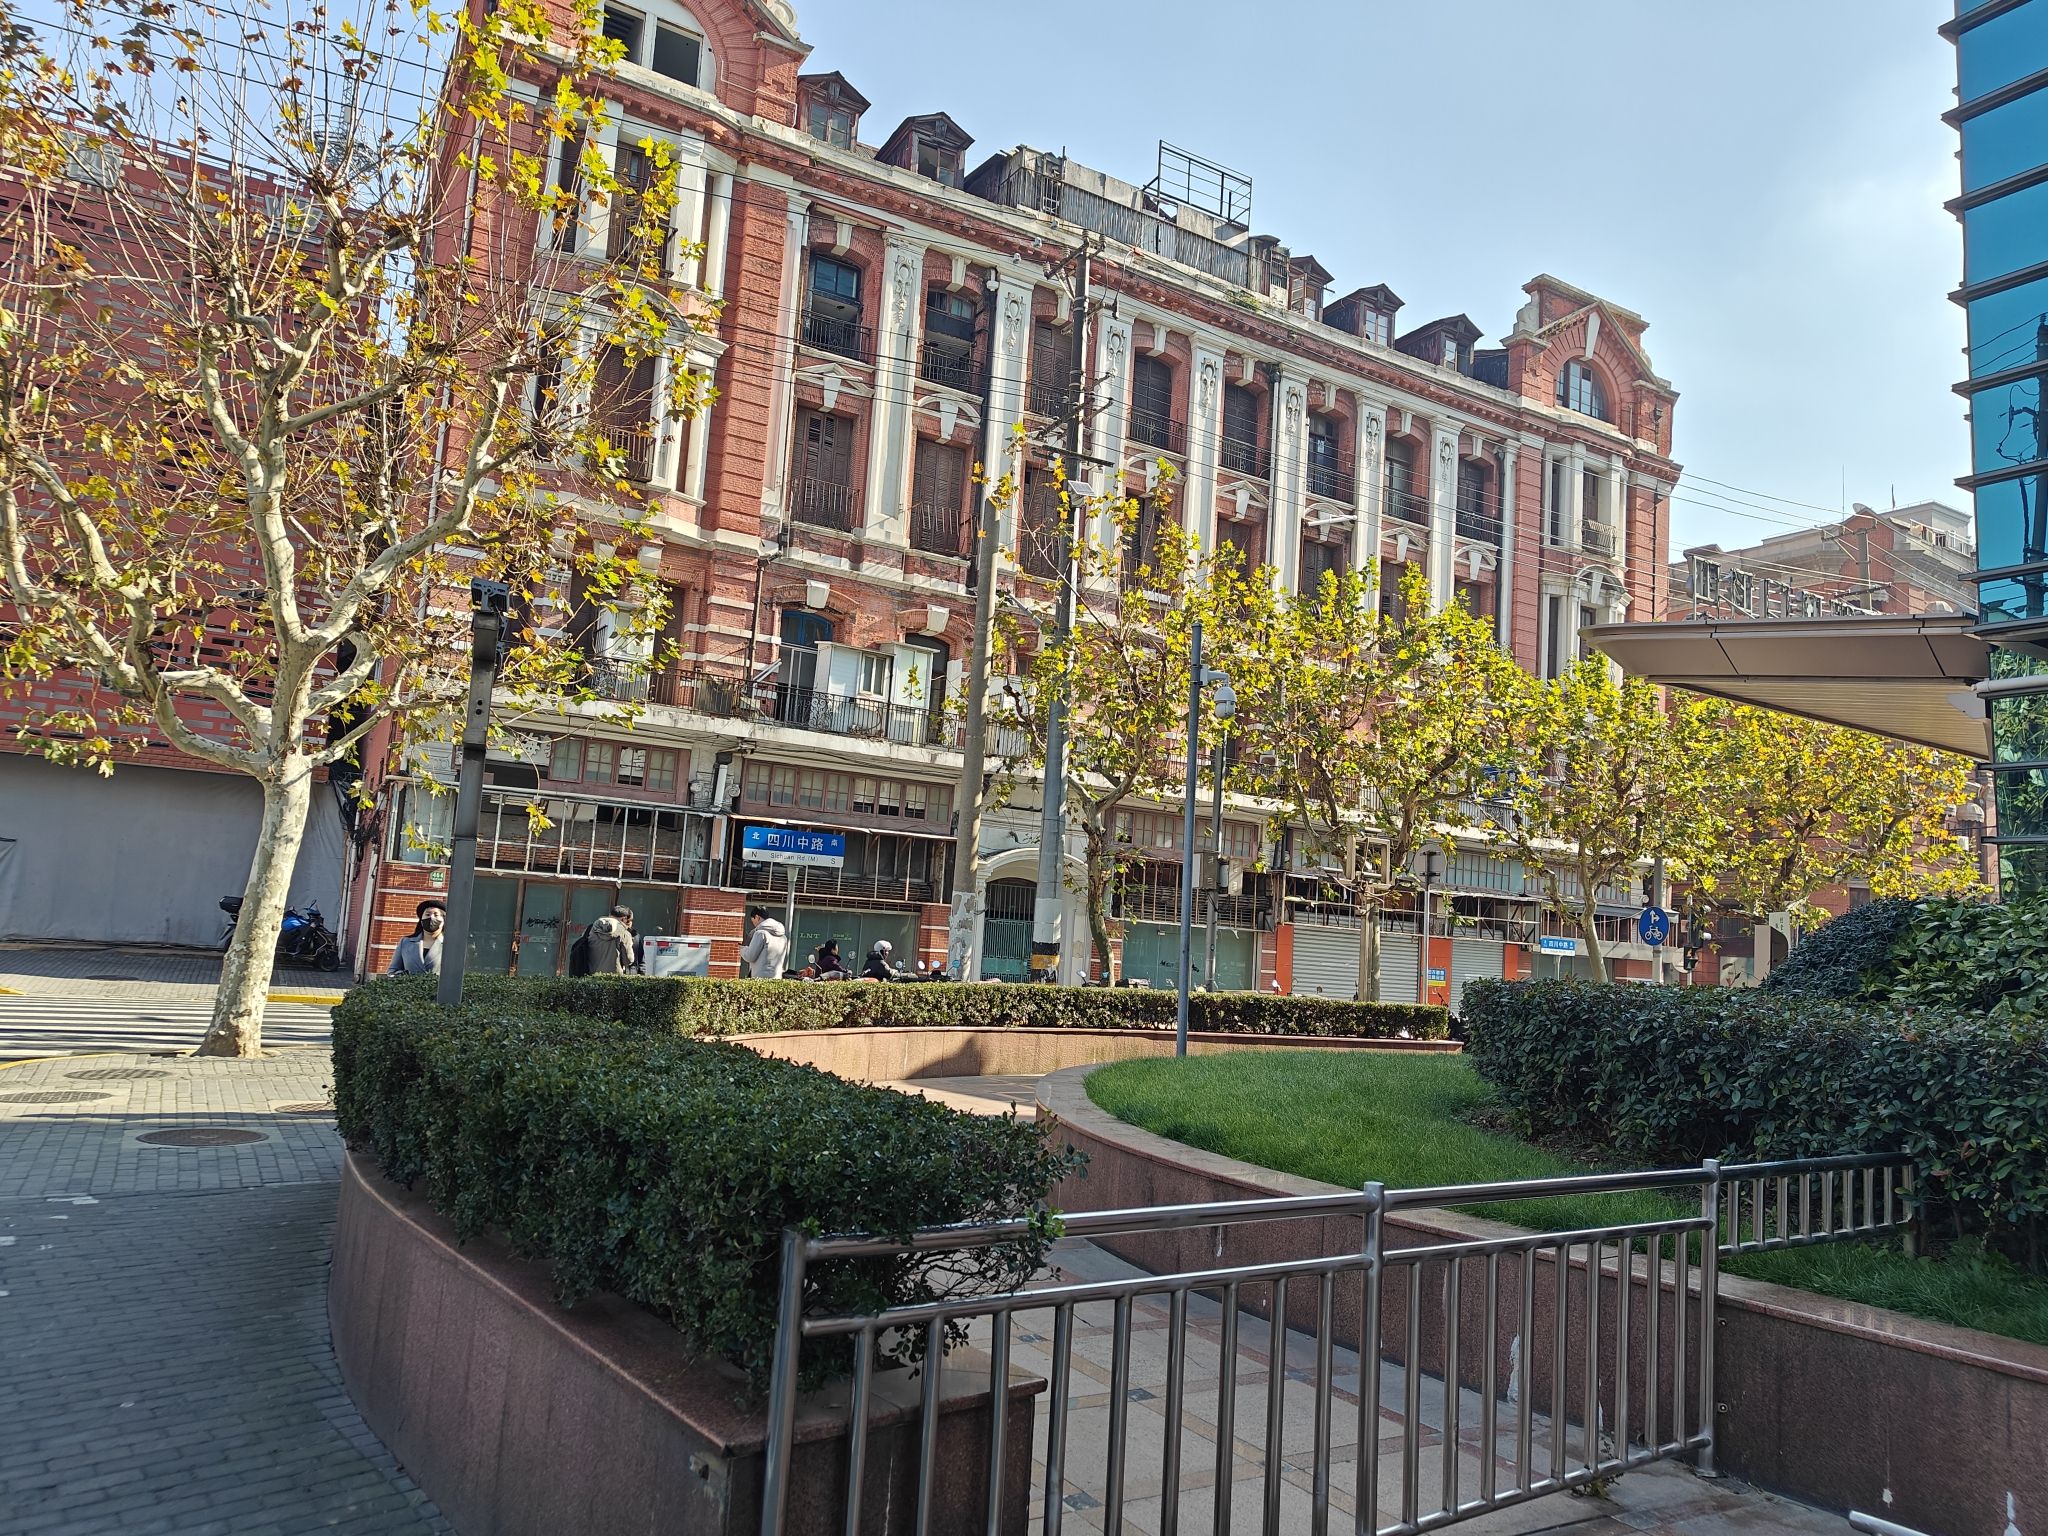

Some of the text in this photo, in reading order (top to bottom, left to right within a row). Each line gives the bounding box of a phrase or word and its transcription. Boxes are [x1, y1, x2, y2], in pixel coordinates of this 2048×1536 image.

[752, 832, 838, 851] 北 四川中路 南
